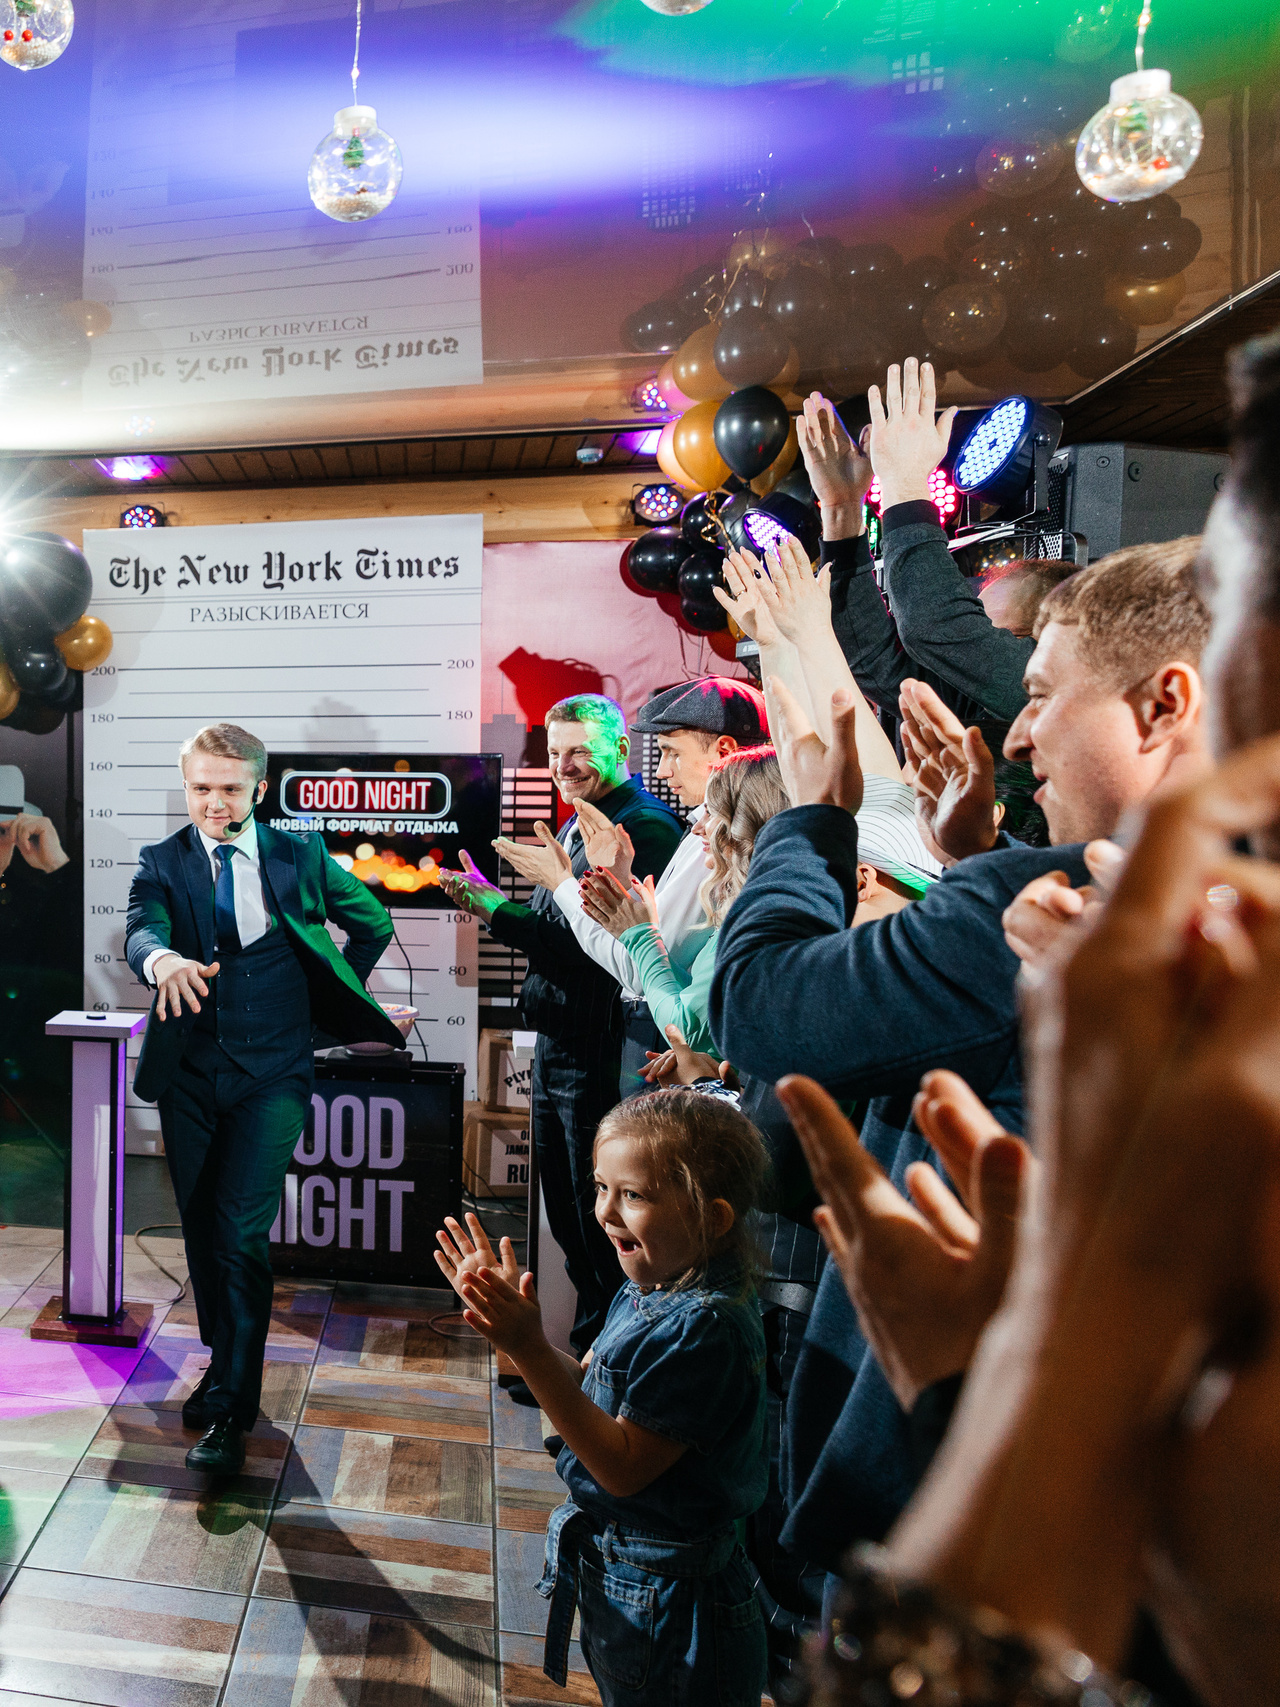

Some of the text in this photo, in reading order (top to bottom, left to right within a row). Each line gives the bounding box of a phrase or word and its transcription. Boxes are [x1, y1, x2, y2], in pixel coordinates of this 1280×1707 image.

[109, 546, 460, 595] The New York Times
[190, 602, 370, 623] РАЗЫСКИВАЕТСЯ
[447, 658, 475, 670] 200
[91, 665, 116, 677] 200
[90, 713, 115, 723] 180
[445, 709, 473, 721] 180
[89, 761, 113, 771] 160
[299, 779, 431, 811] GOOD NIGHT
[88, 808, 113, 819] 140
[270, 816, 459, 835] НОВЫЙ ФОРМАТ ОТДЫХА
[89, 858, 113, 869] 120
[90, 904, 114, 915] 100
[445, 912, 473, 924] 100
[94, 953, 111, 964] 80
[448, 964, 467, 976] 80
[93, 1002, 110, 1012] 60
[447, 1015, 465, 1026] 60
[293, 1092, 405, 1170] OOD
